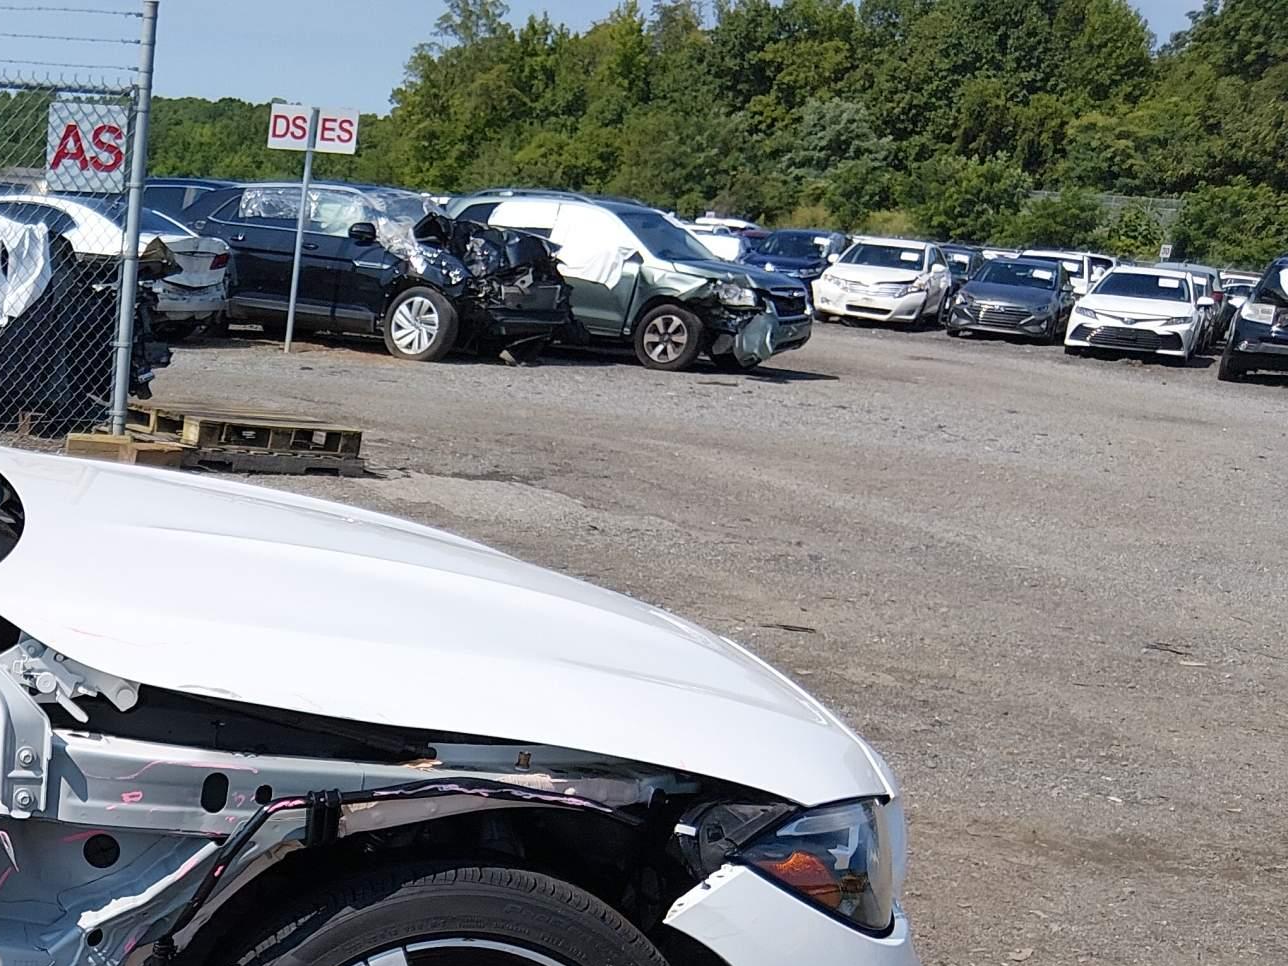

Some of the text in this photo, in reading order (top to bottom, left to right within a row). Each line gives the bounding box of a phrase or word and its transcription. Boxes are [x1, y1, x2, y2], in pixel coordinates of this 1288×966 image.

[271, 114, 307, 140] DS
[319, 118, 353, 143] ES
[50, 123, 124, 172] AS
